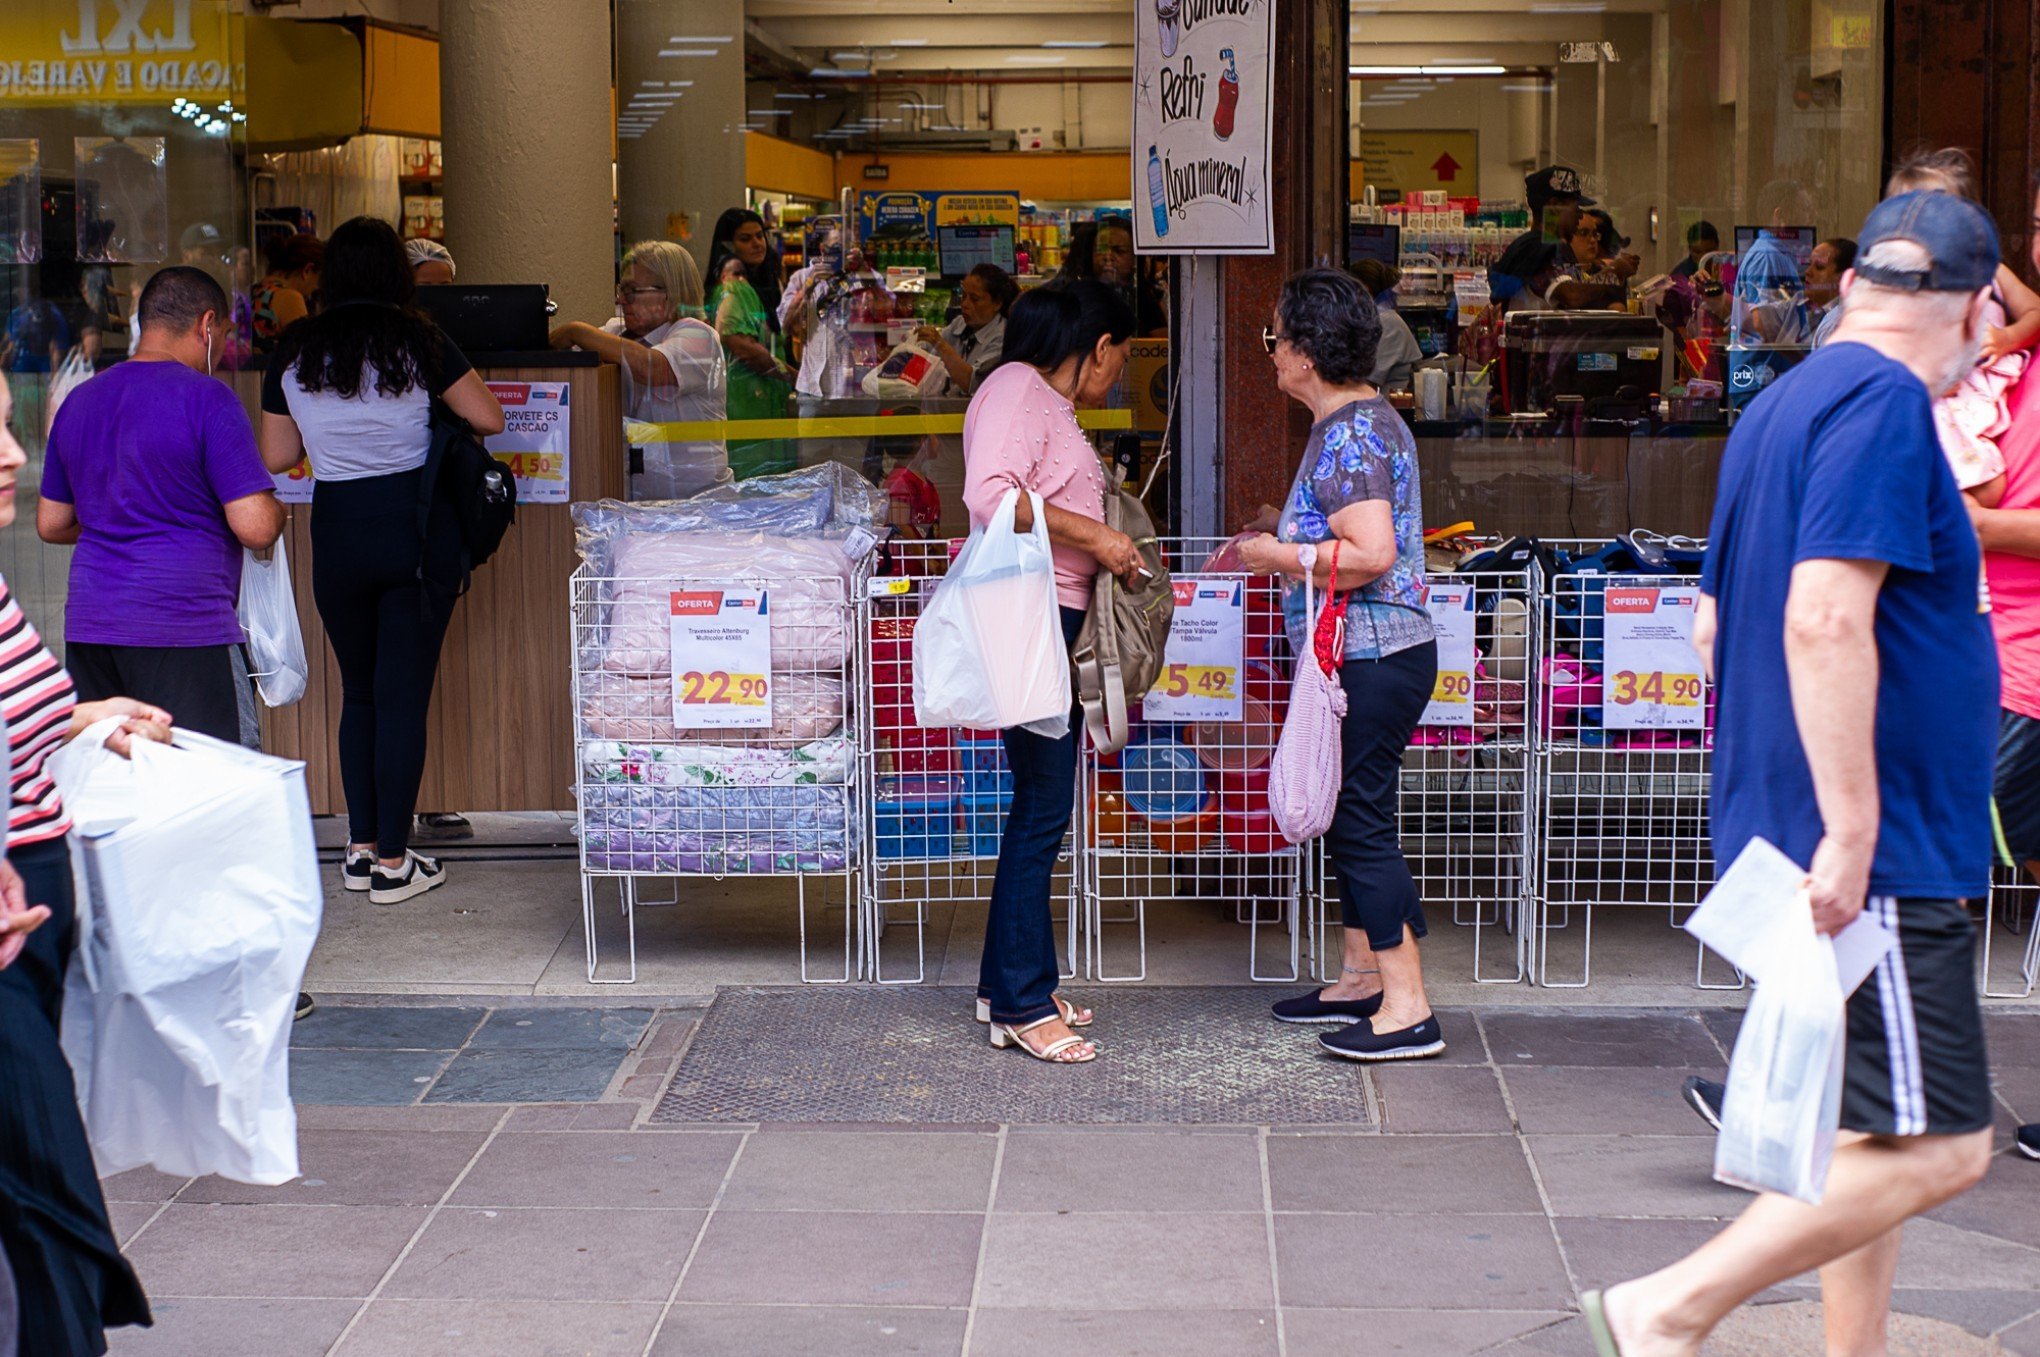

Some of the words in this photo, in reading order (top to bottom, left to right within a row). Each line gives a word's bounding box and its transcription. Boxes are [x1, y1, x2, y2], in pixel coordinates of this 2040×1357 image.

[1160, 55, 1207, 123] Refri
[1165, 149, 1197, 220] Água
[1198, 156, 1247, 206] mineral
[1733, 370, 1752, 381] prix
[505, 411, 542, 421] ORVETE
[545, 411, 559, 421] CS
[508, 422, 549, 432] CASCAO
[677, 599, 714, 608] OFERTA
[1612, 597, 1650, 606] OFERTA
[1166, 663, 1189, 698] 5
[1198, 671, 1227, 691] 49
[1442, 676, 1471, 696] 90
[1614, 670, 1665, 705] 34
[1673, 679, 1702, 698] 90
